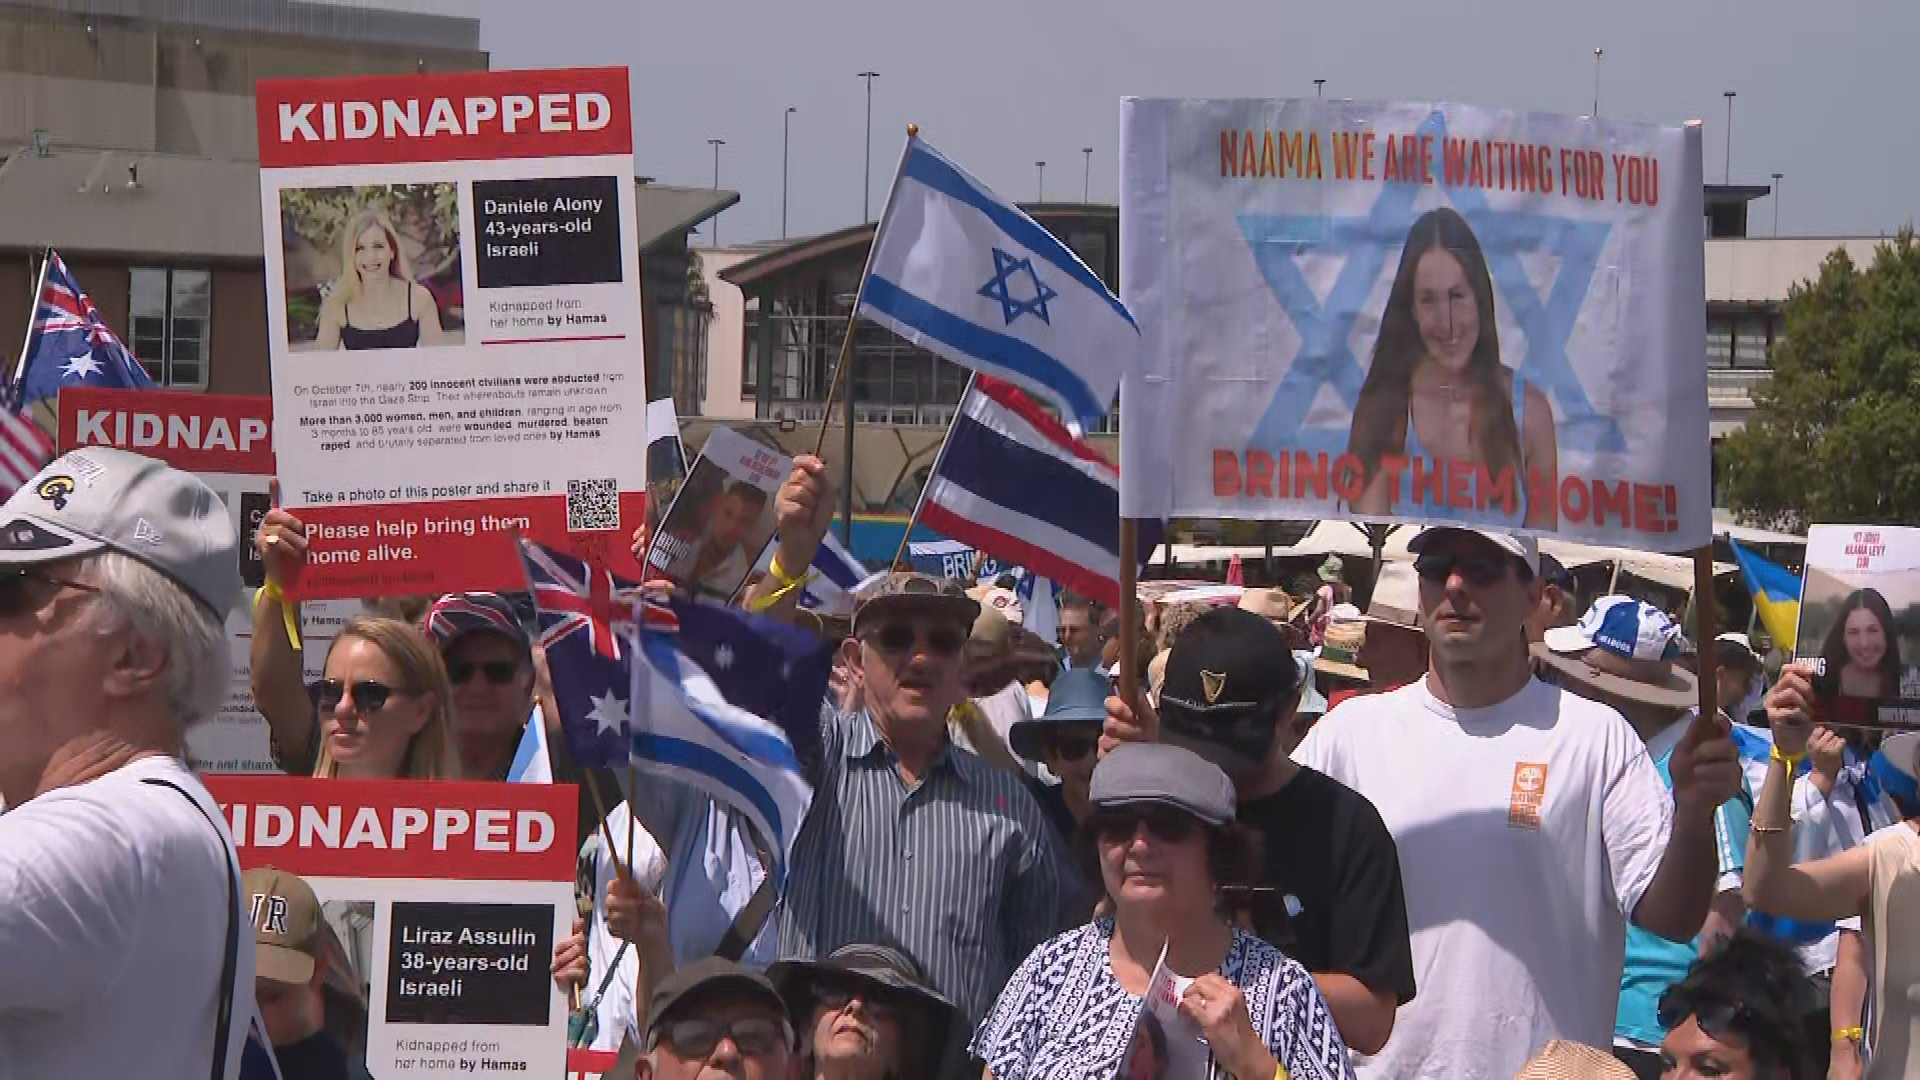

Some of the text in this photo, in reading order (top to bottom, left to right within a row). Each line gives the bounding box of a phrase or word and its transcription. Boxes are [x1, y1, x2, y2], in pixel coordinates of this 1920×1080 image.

[277, 92, 611, 143] KIDNAPPED
[1220, 130, 1658, 207] NAAMA WE ARE WAITING FOR YOU
[484, 197, 603, 215] Daniele Alony
[485, 217, 592, 239] 43-years-old
[486, 241, 538, 258] Israeli
[489, 298, 582, 312] Kidnapped from
[490, 313, 607, 328] her home by Hamas
[293, 385, 309, 396] On
[311, 384, 351, 395] October
[409, 380, 427, 391] 200
[430, 378, 476, 390] innocent
[479, 376, 521, 387] civilians
[524, 376, 548, 385] were
[552, 373, 600, 385] abducted
[300, 416, 326, 427] More
[329, 415, 352, 425] than
[355, 413, 382, 424] 3,000
[457, 409, 476, 419] and
[76, 408, 270, 453] KIDNAP
[550, 430, 562, 441] by
[565, 429, 600, 439] Hamas
[303, 479, 551, 504] Take a photo of this poster and share it
[1212, 447, 1679, 533] BRING THEM HOME!
[305, 514, 530, 540] Please help bring them
[307, 544, 418, 564] home alive.
[220, 804, 556, 854] IDNAPPED
[402, 926, 536, 946] Liraz Assulin
[401, 951, 529, 975] 38-years-old
[399, 978, 463, 997] Israeli
[396, 1039, 500, 1054] Kidnapped from
[394, 1057, 528, 1072] her home by Hamas
